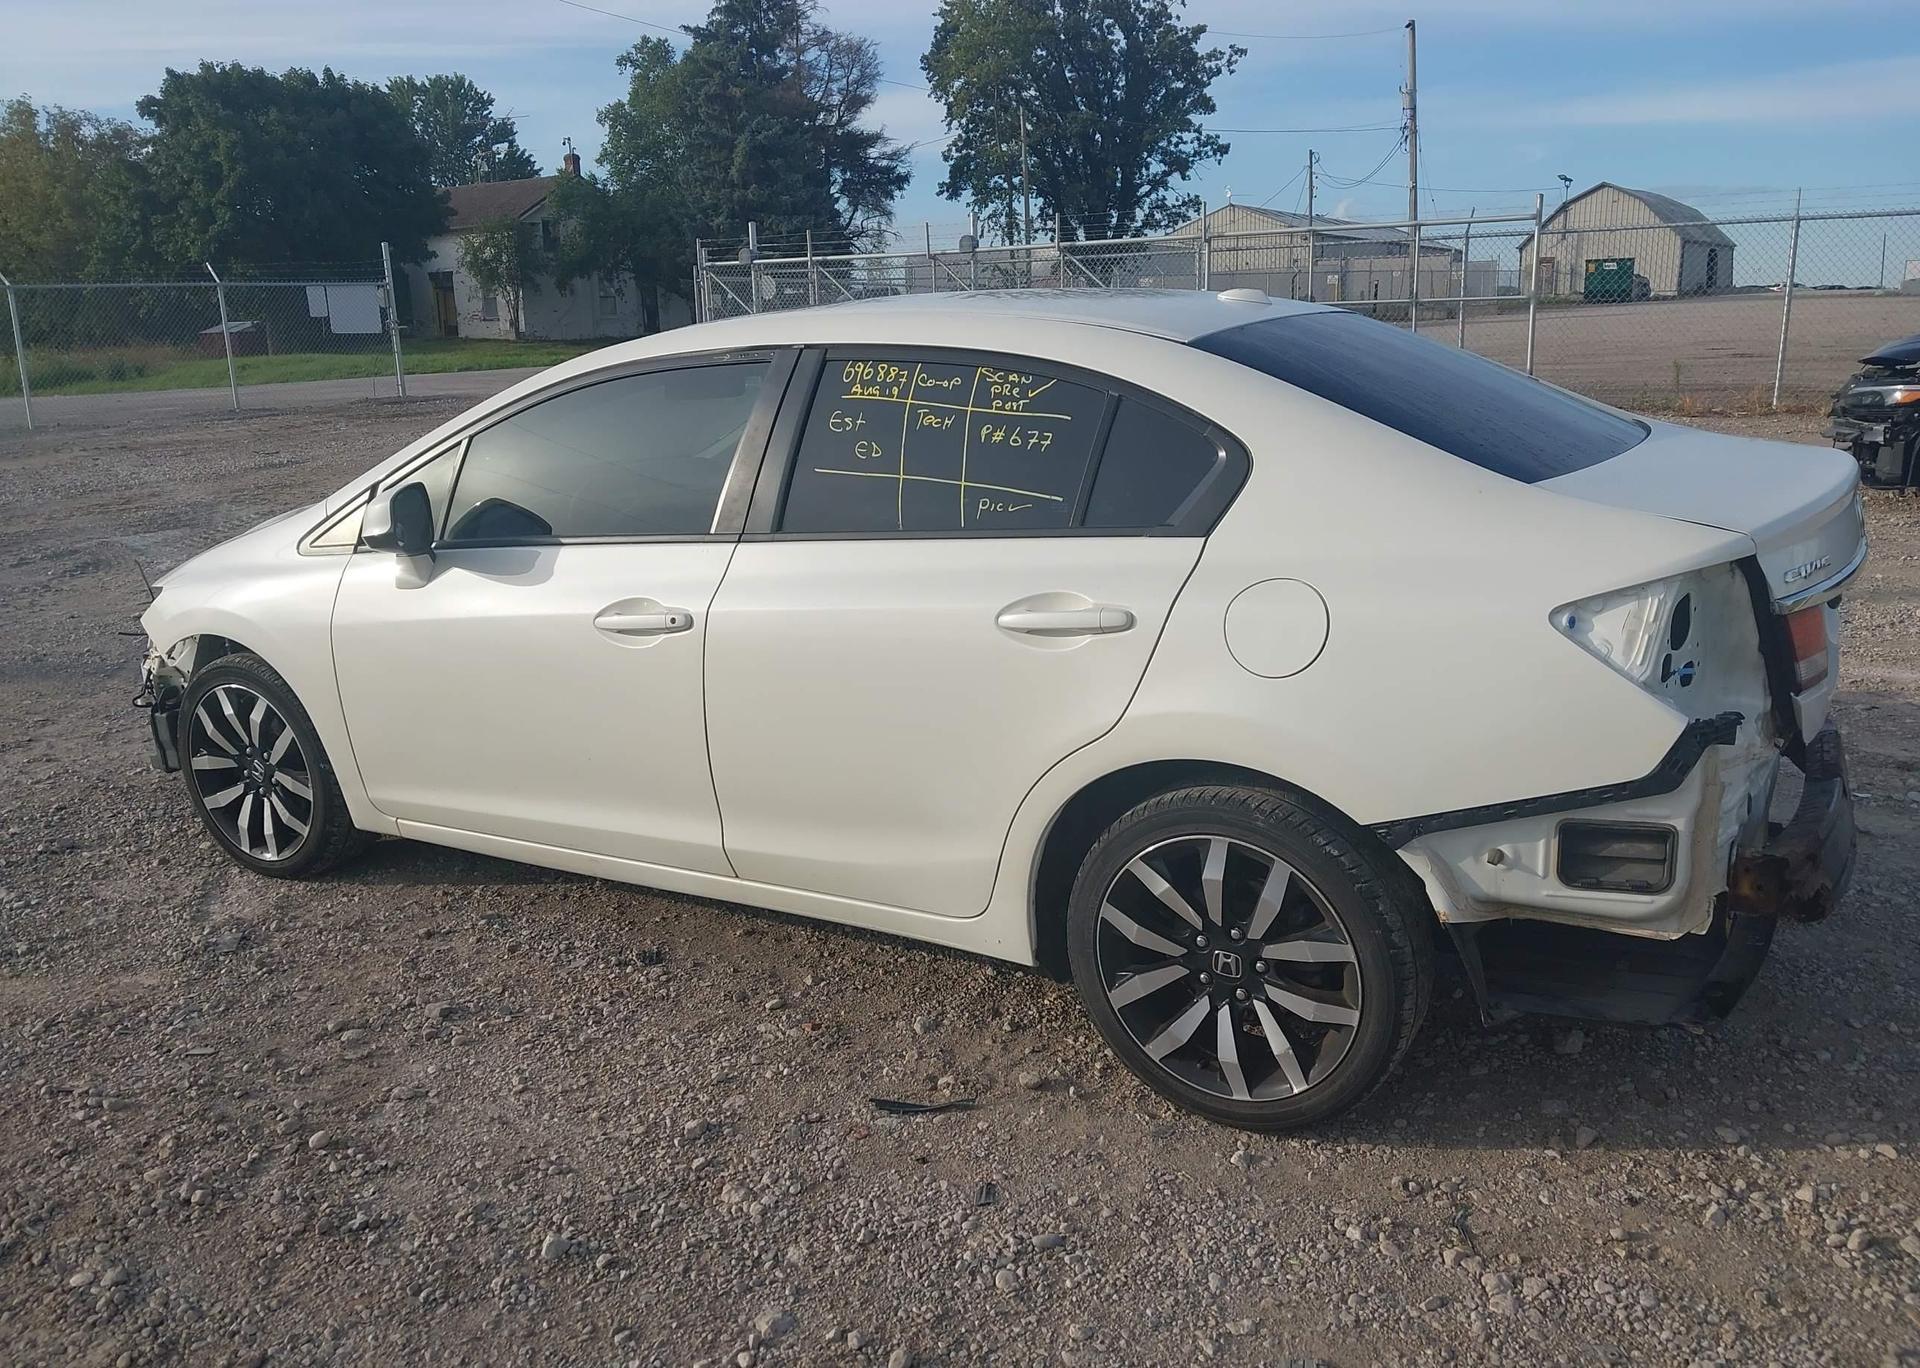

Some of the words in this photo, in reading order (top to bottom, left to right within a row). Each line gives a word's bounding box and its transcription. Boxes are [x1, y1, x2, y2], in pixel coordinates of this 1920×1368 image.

[843, 360, 908, 390] 696887
[981, 367, 1033, 384] SCAN
[885, 386, 899, 400] 19
[829, 410, 866, 432] Est
[855, 441, 882, 459] ED
[1783, 554, 1831, 584] CIVIC
